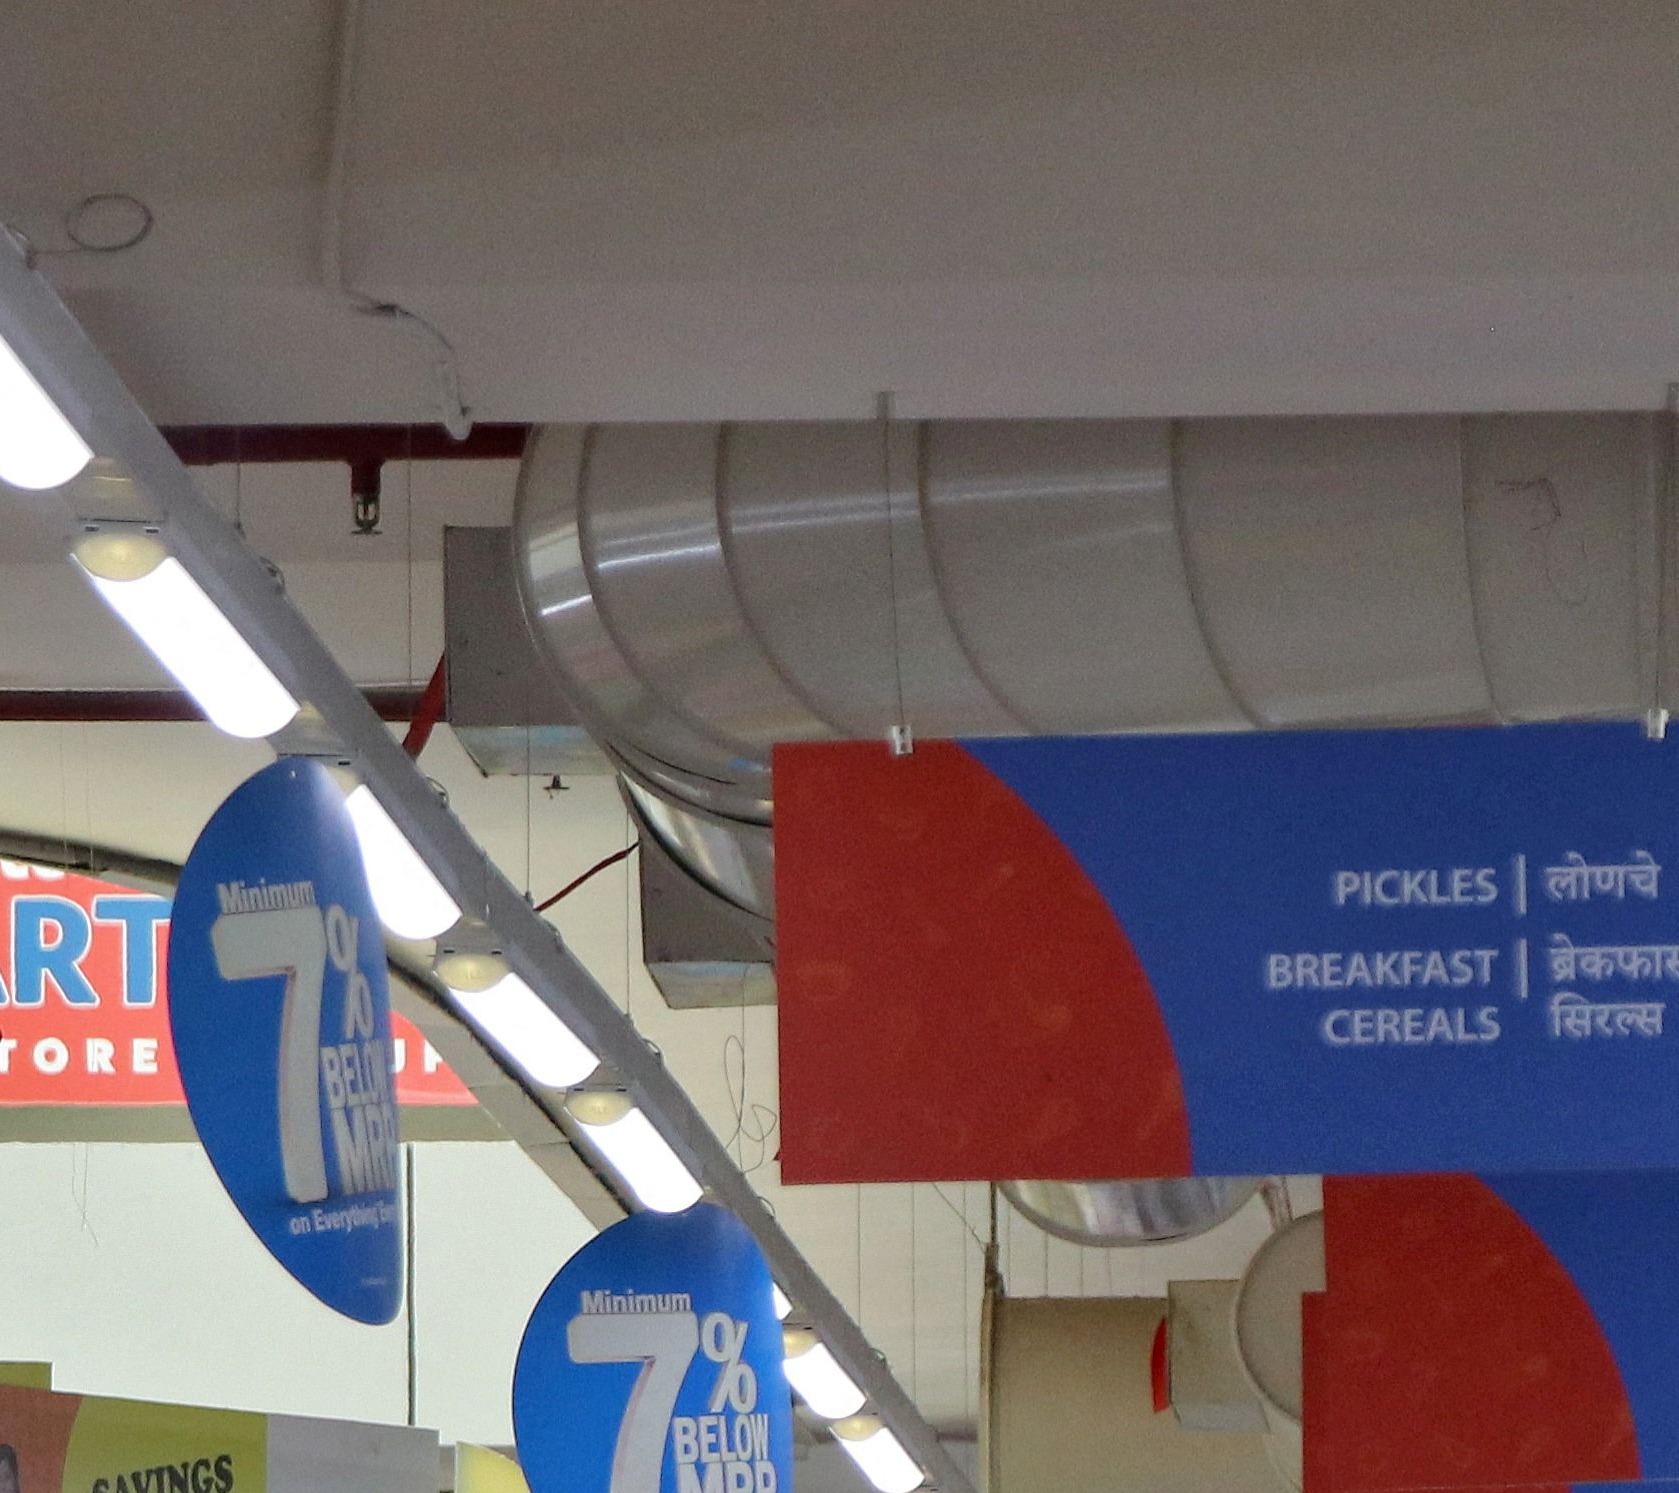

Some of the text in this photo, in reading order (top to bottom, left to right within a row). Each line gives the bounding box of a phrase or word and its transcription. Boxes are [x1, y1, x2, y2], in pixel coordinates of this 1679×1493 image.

[1334, 867, 1498, 906] PICKLES
[1544, 849, 1662, 900] लोणचे
[217, 878, 315, 914] Minimum
[1266, 948, 1500, 989] BREAKFAST
[1323, 1006, 1501, 1046] CEREALS
[289, 1212, 312, 1237] on
[580, 1290, 692, 1314] Minimum
[673, 1414, 769, 1464] BELOW
